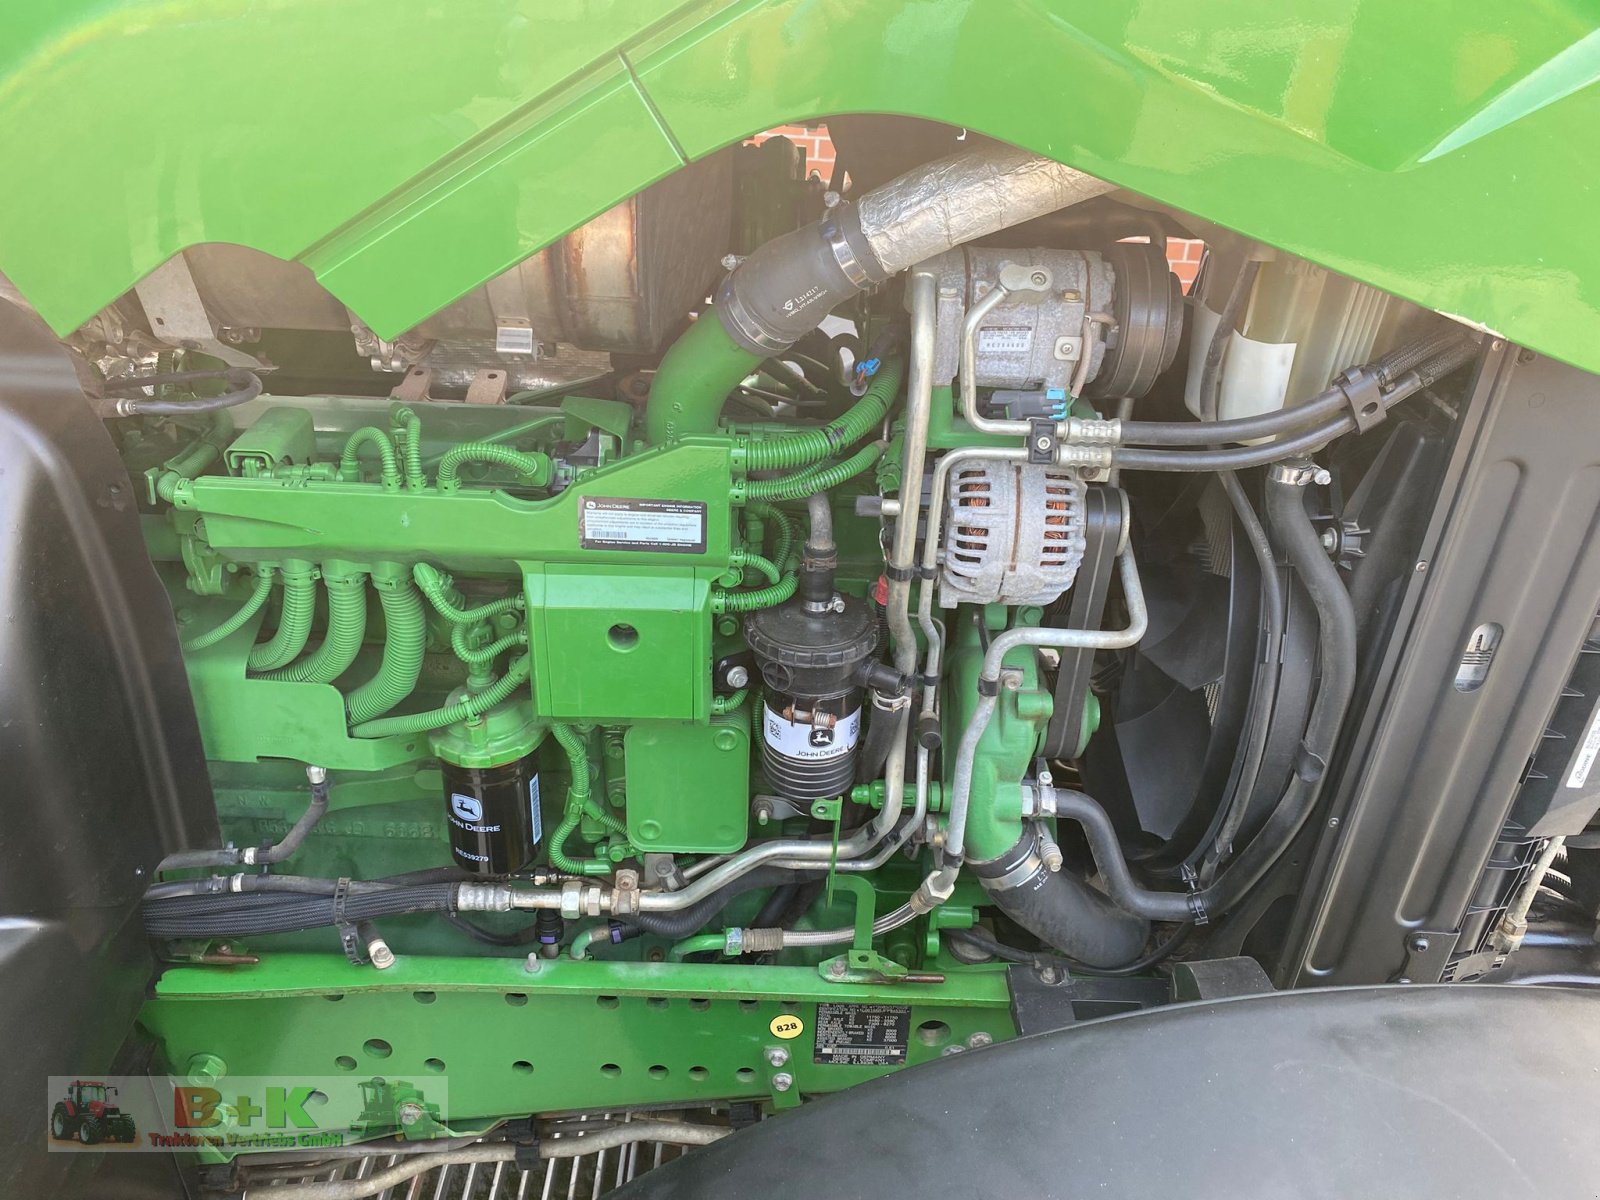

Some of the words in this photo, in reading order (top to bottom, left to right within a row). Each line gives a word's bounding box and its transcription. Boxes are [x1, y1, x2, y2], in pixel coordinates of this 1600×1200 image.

[820, 746, 844, 756] DEERE
[447, 812, 464, 829] OHN
[465, 823, 501, 833] DEERE
[776, 1022, 798, 1032] 828
